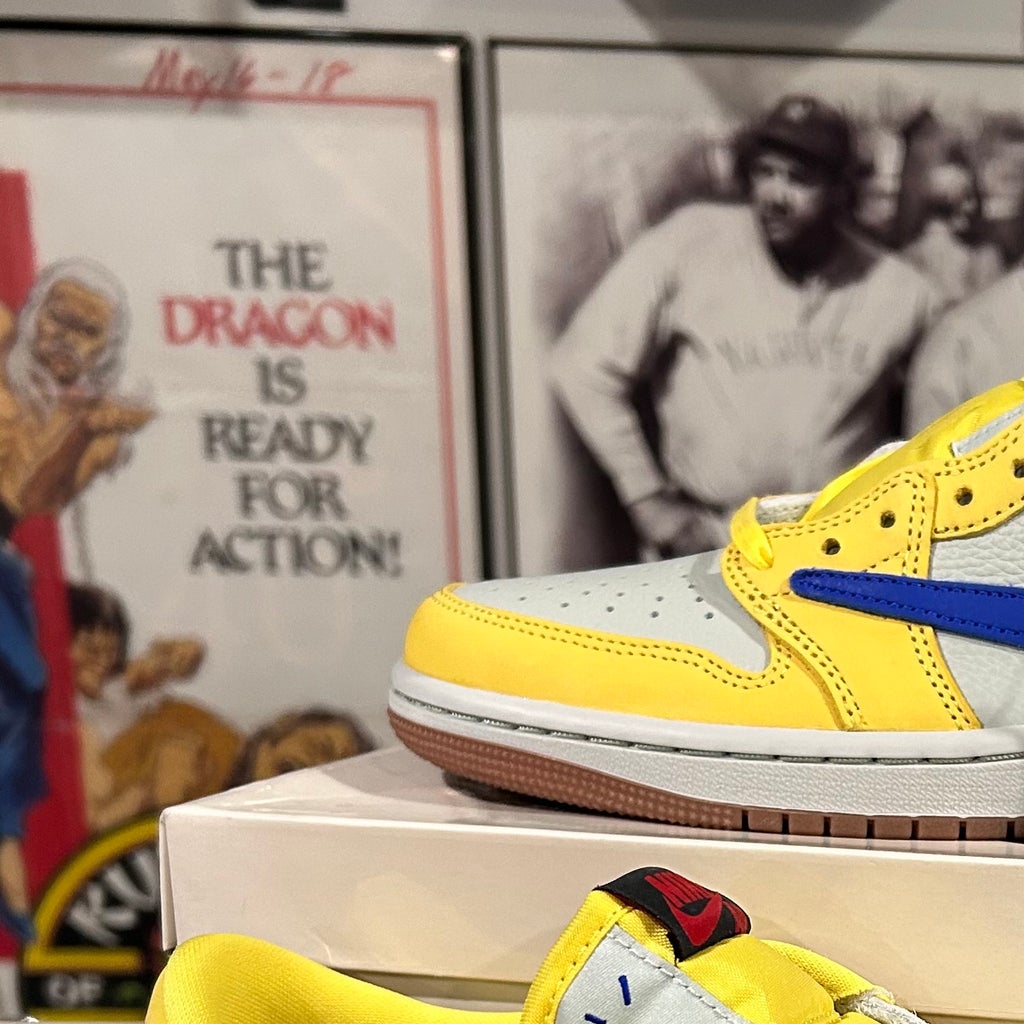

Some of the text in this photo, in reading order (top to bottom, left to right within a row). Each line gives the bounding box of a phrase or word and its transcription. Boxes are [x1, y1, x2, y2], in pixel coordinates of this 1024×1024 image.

[213, 237, 333, 292] THE
[161, 294, 395, 350] DRAGON
[255, 356, 308, 405] IS
[201, 412, 375, 464] READY
[235, 470, 348, 521] FOR
[189, 527, 404, 577] ACTION!
